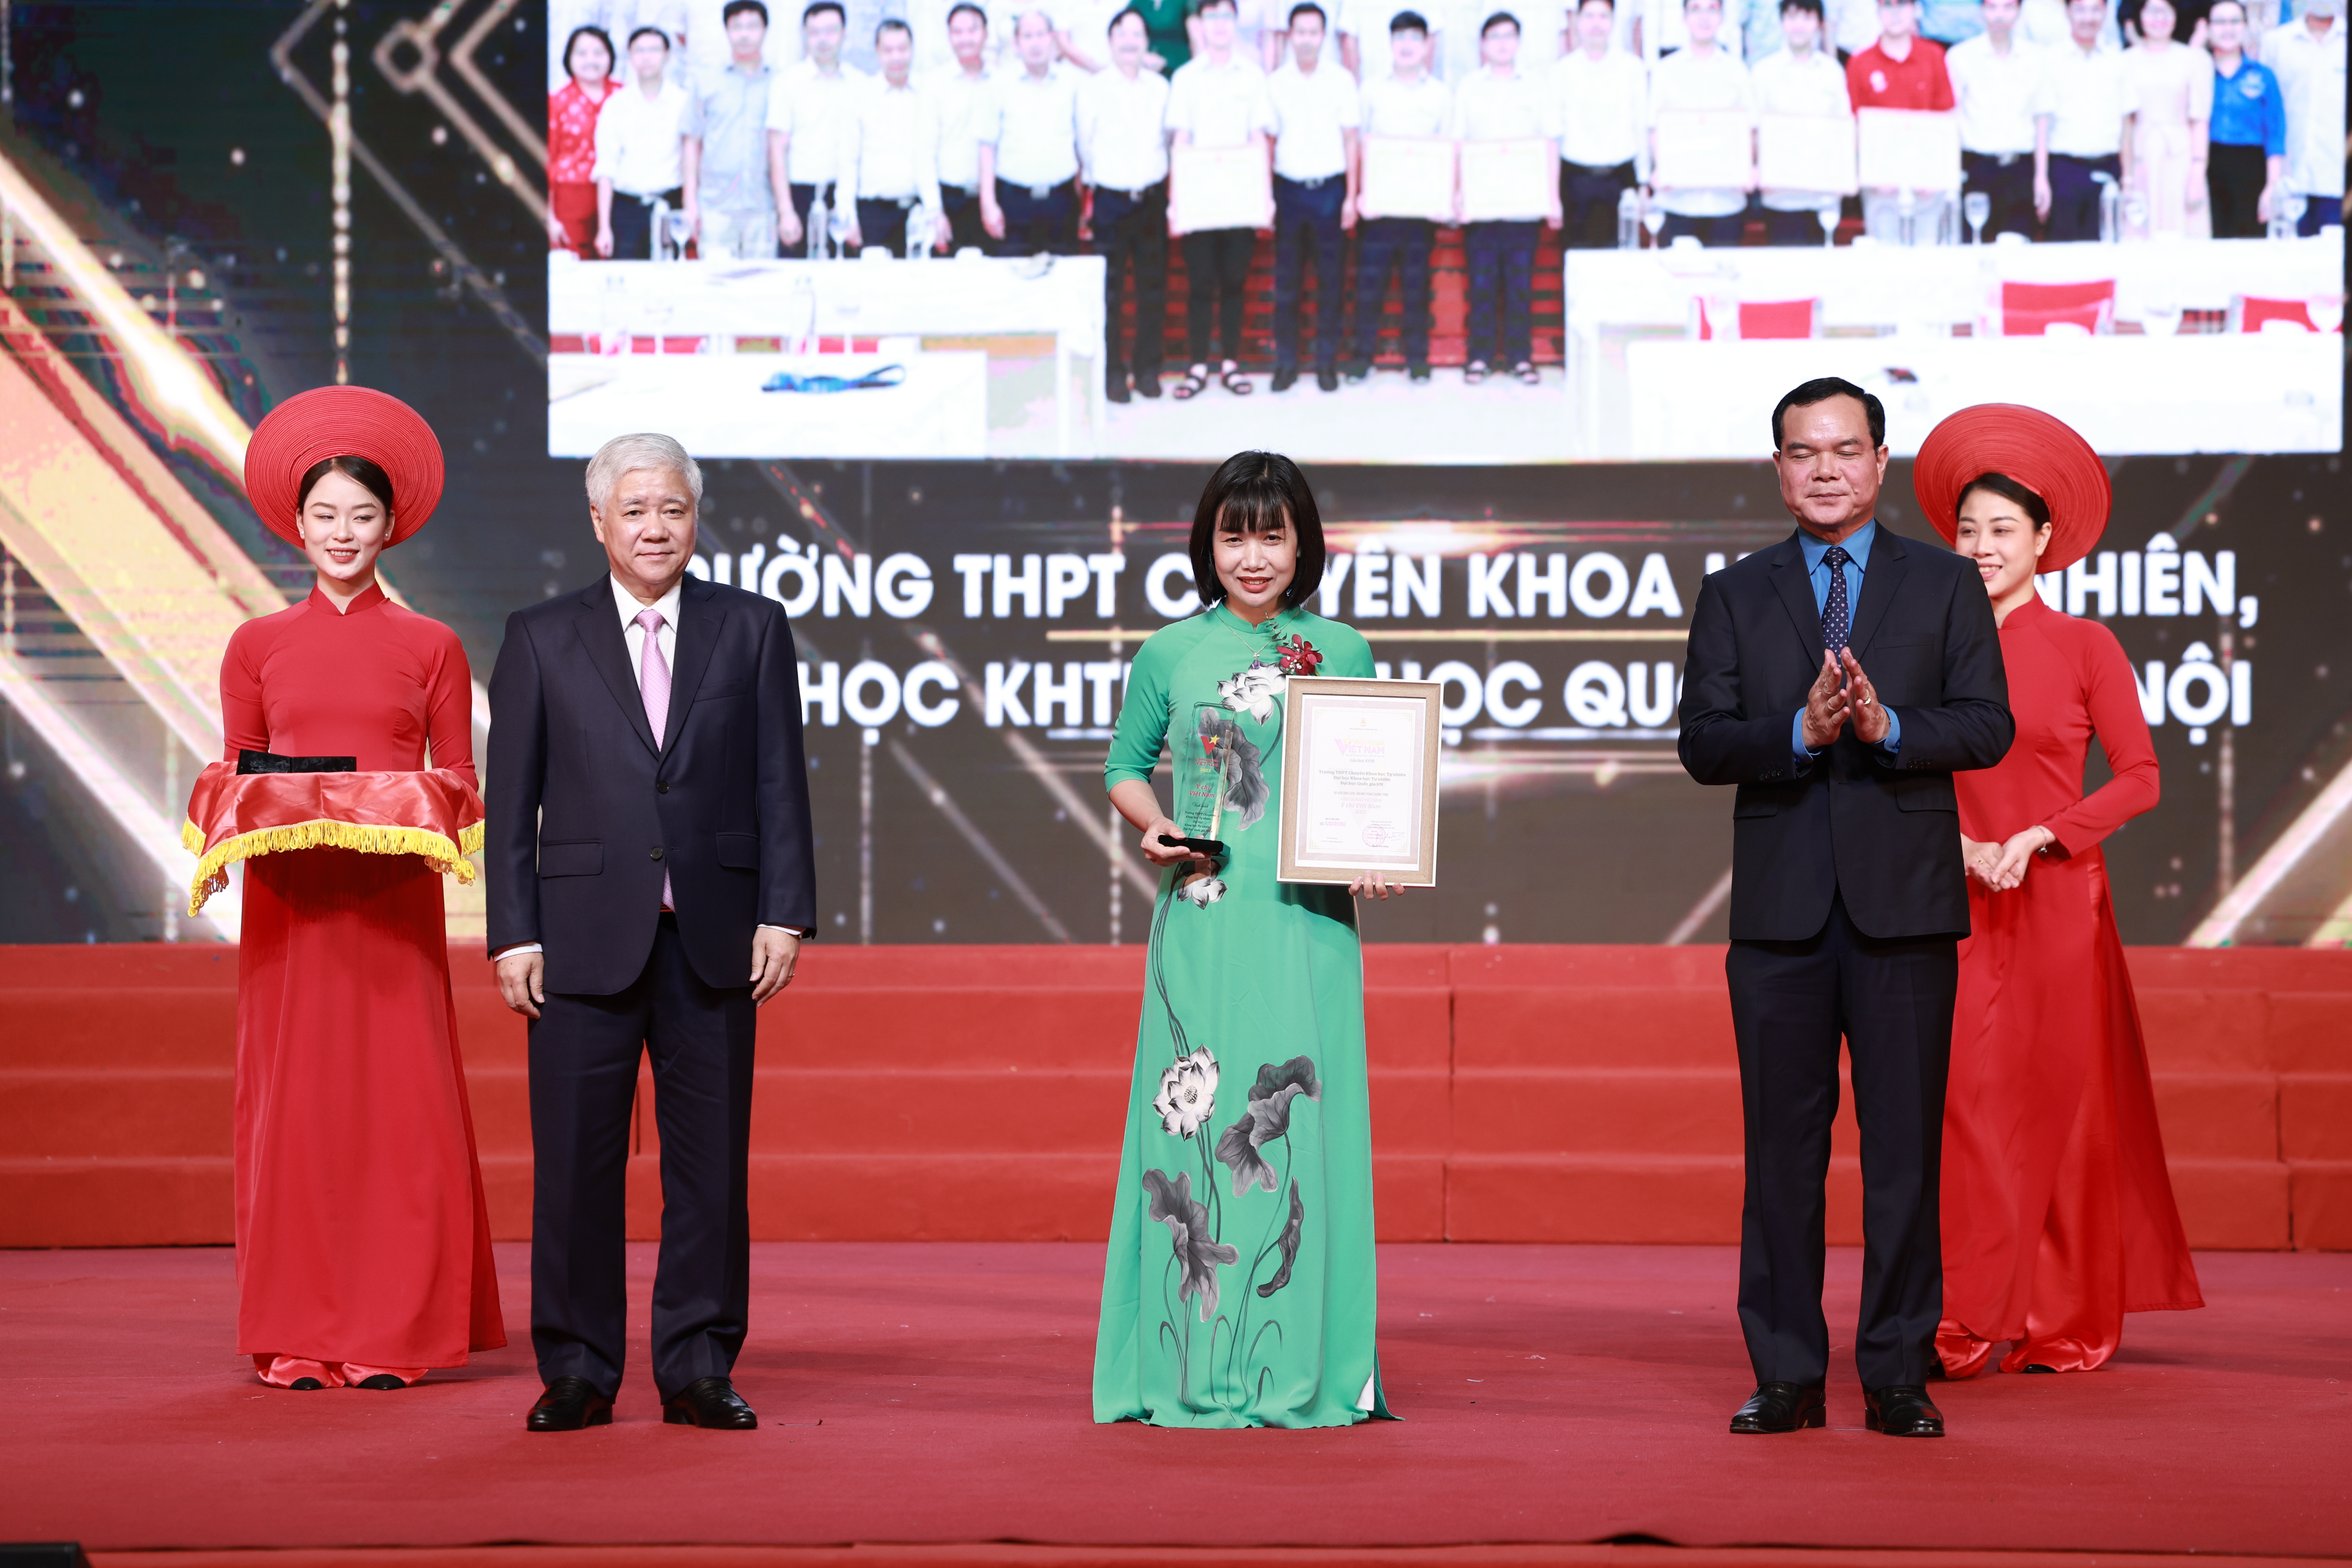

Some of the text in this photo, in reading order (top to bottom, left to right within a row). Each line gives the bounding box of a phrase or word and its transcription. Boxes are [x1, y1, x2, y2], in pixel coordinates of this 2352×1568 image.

[685, 534, 934, 619] ƯỜNG
[953, 553, 1126, 618] THPT
[1145, 535, 1441, 618] CYÊN
[1468, 552, 1683, 618] KHOA
[797, 641, 2252, 746] HỌC KHT ỌC QU NỘI
[1364, 746, 1385, 754] NAM
